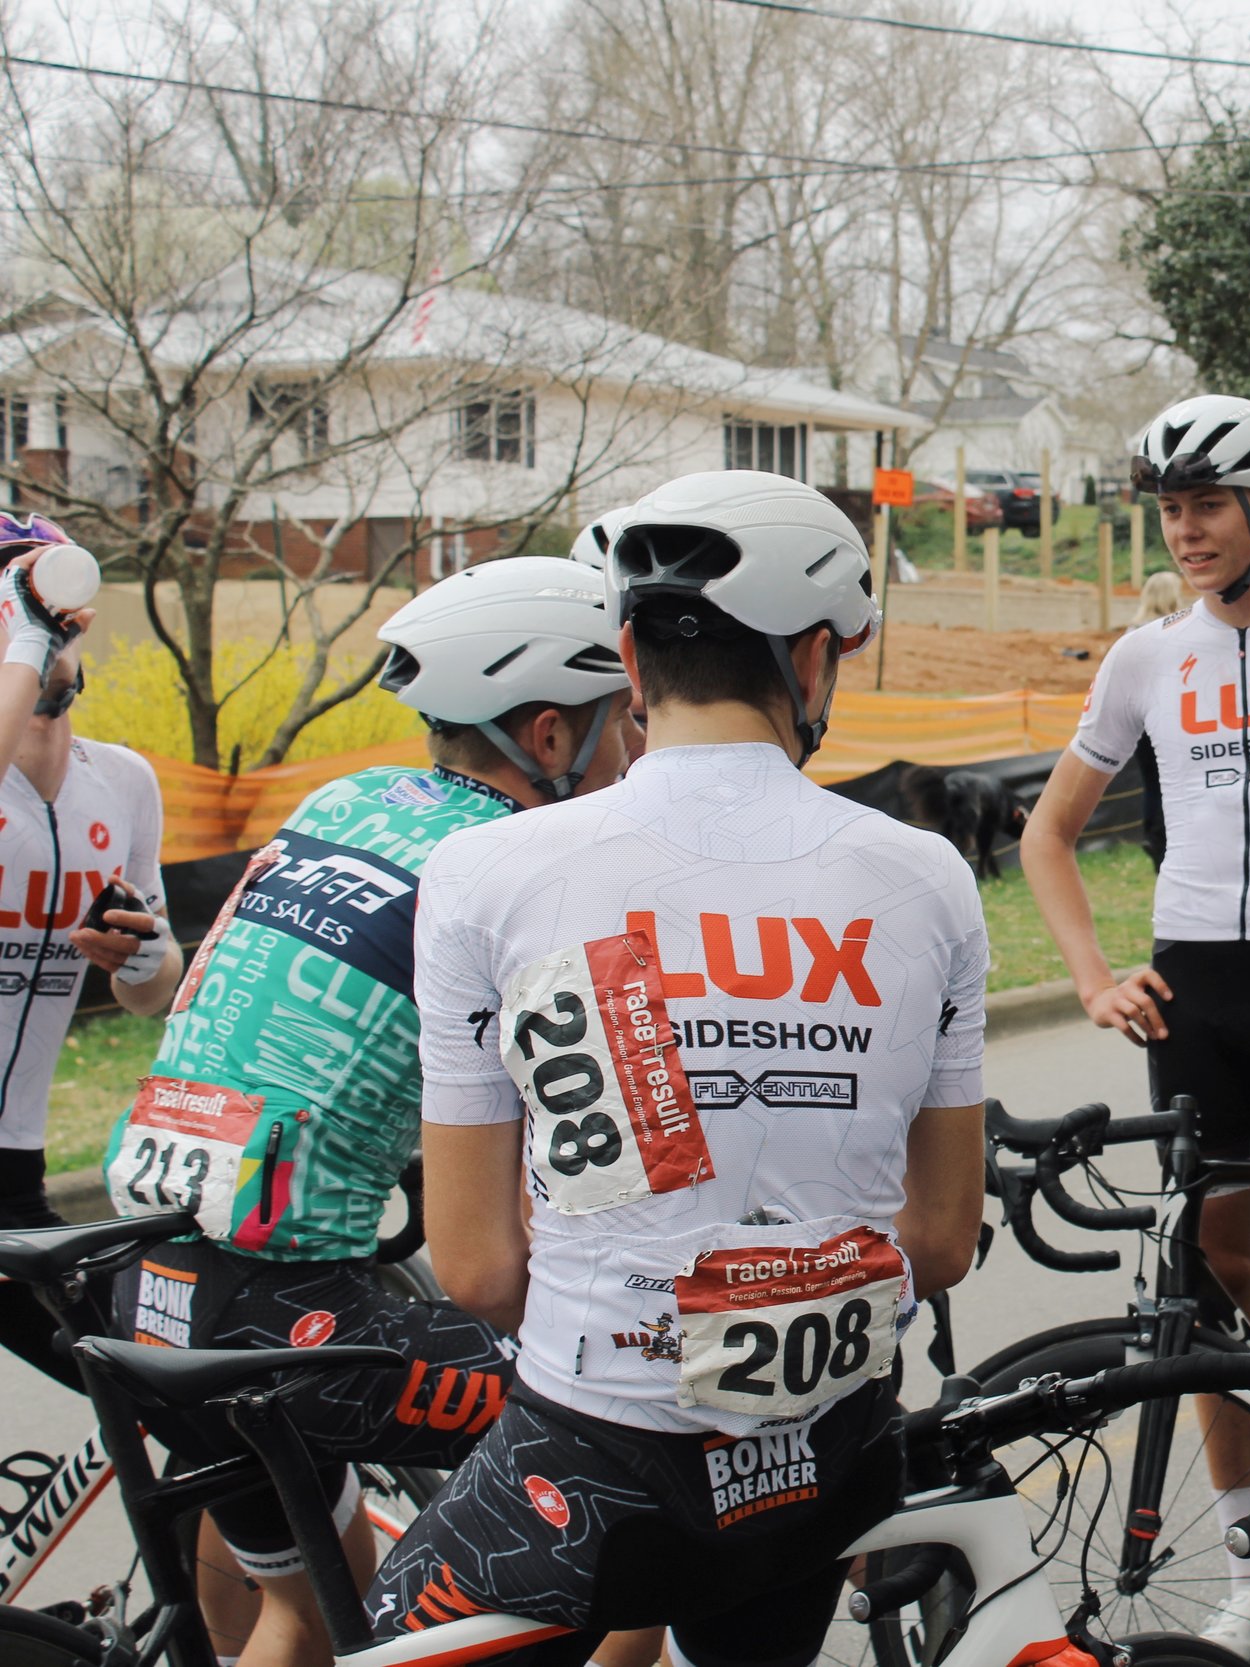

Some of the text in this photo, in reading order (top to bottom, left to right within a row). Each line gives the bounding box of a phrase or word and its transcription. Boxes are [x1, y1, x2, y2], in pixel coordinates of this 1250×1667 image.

[271, 900, 354, 946] SALES
[626, 911, 883, 1008] LUX
[514, 991, 623, 1177] 208
[623, 980, 690, 1139] race result
[624, 1064, 638, 1096] German
[694, 1082, 850, 1099] FLEXENTIAL
[138, 1269, 196, 1322] BONK
[725, 1257, 788, 1285] race
[729, 1290, 769, 1302] Precision.
[135, 1305, 191, 1349] BREAKER
[611, 1332, 651, 1349] MAD
[717, 1298, 872, 1397] 208
[395, 1359, 512, 1434] LUX
[705, 1423, 816, 1489] BONK
[712, 1461, 818, 1516] BREAKER
